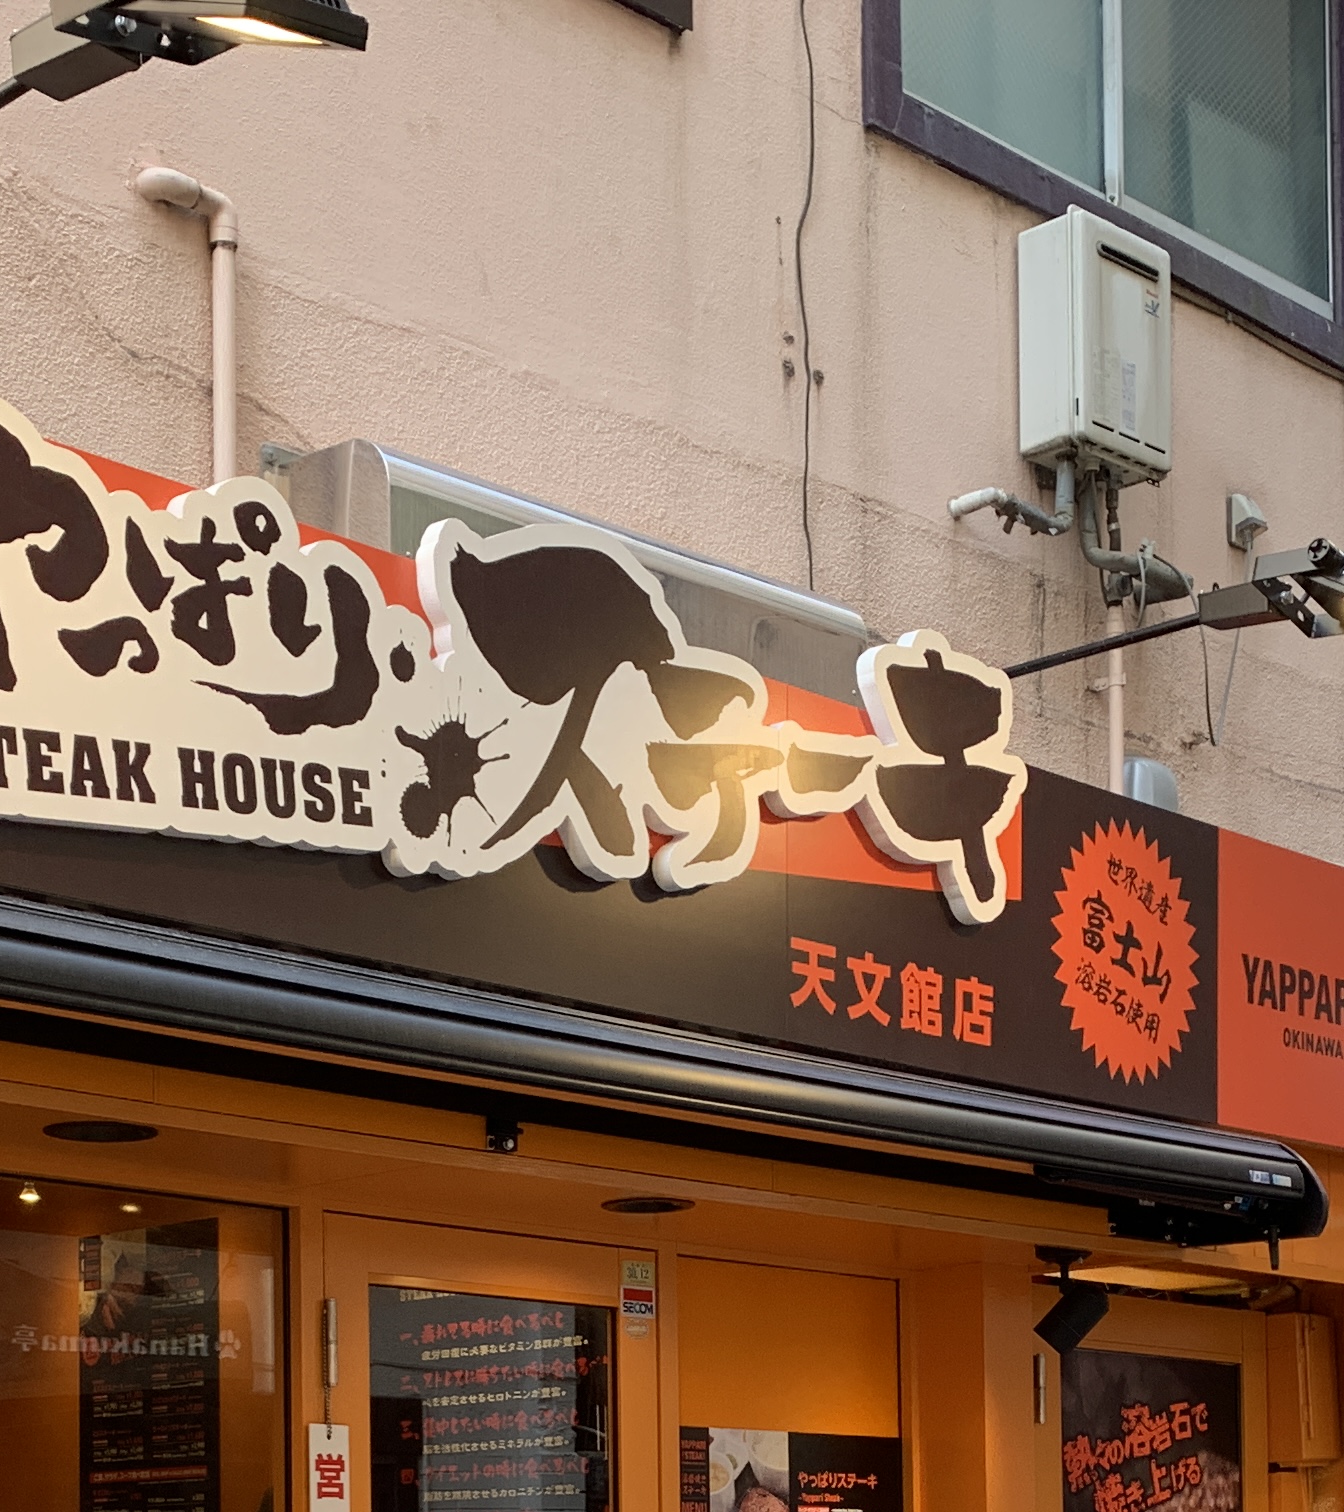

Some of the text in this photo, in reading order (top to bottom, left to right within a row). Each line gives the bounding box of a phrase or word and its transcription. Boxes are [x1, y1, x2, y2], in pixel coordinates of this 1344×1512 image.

[179, 745, 375, 828] HOUSE
[1107, 852, 1173, 926] 世界遺産
[1082, 889, 1172, 1005] 富士山
[789, 936, 996, 1047] 天文館店
[1075, 957, 1160, 1044] 溶岩石使用
[1283, 1027, 1344, 1060] OKINAWA
[623, 1302, 654, 1315] SECOM
